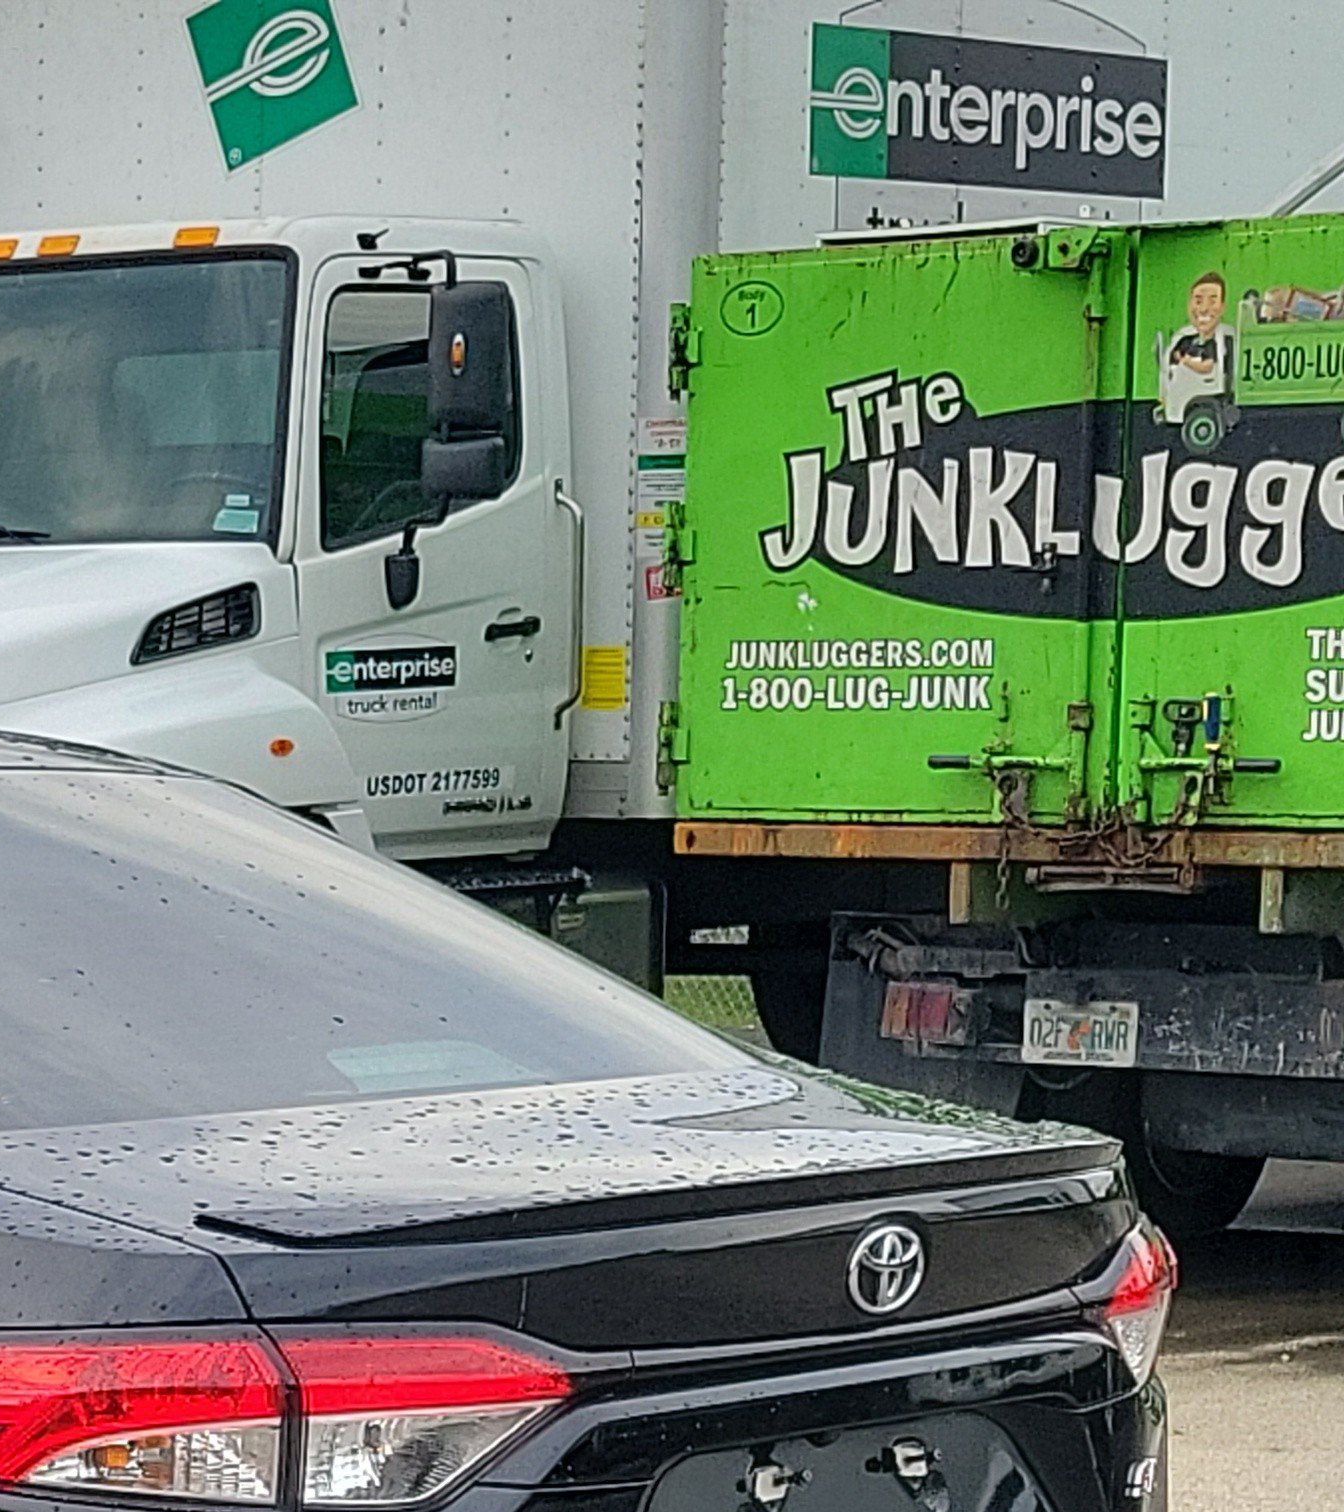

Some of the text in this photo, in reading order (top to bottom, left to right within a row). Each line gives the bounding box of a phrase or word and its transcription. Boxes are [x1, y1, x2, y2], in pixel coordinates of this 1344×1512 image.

[809, 67, 1163, 171] enterprise
[746, 303, 756, 328] 1
[1241, 343, 1344, 382] 1-800-LU
[326, 652, 454, 685] enterprise
[724, 638, 994, 669] JUNKLUGGERS.COM
[348, 691, 437, 714] truck rental
[720, 675, 992, 710] 1-800-LUG-JUNK
[367, 767, 500, 796] USDOT 2177599
